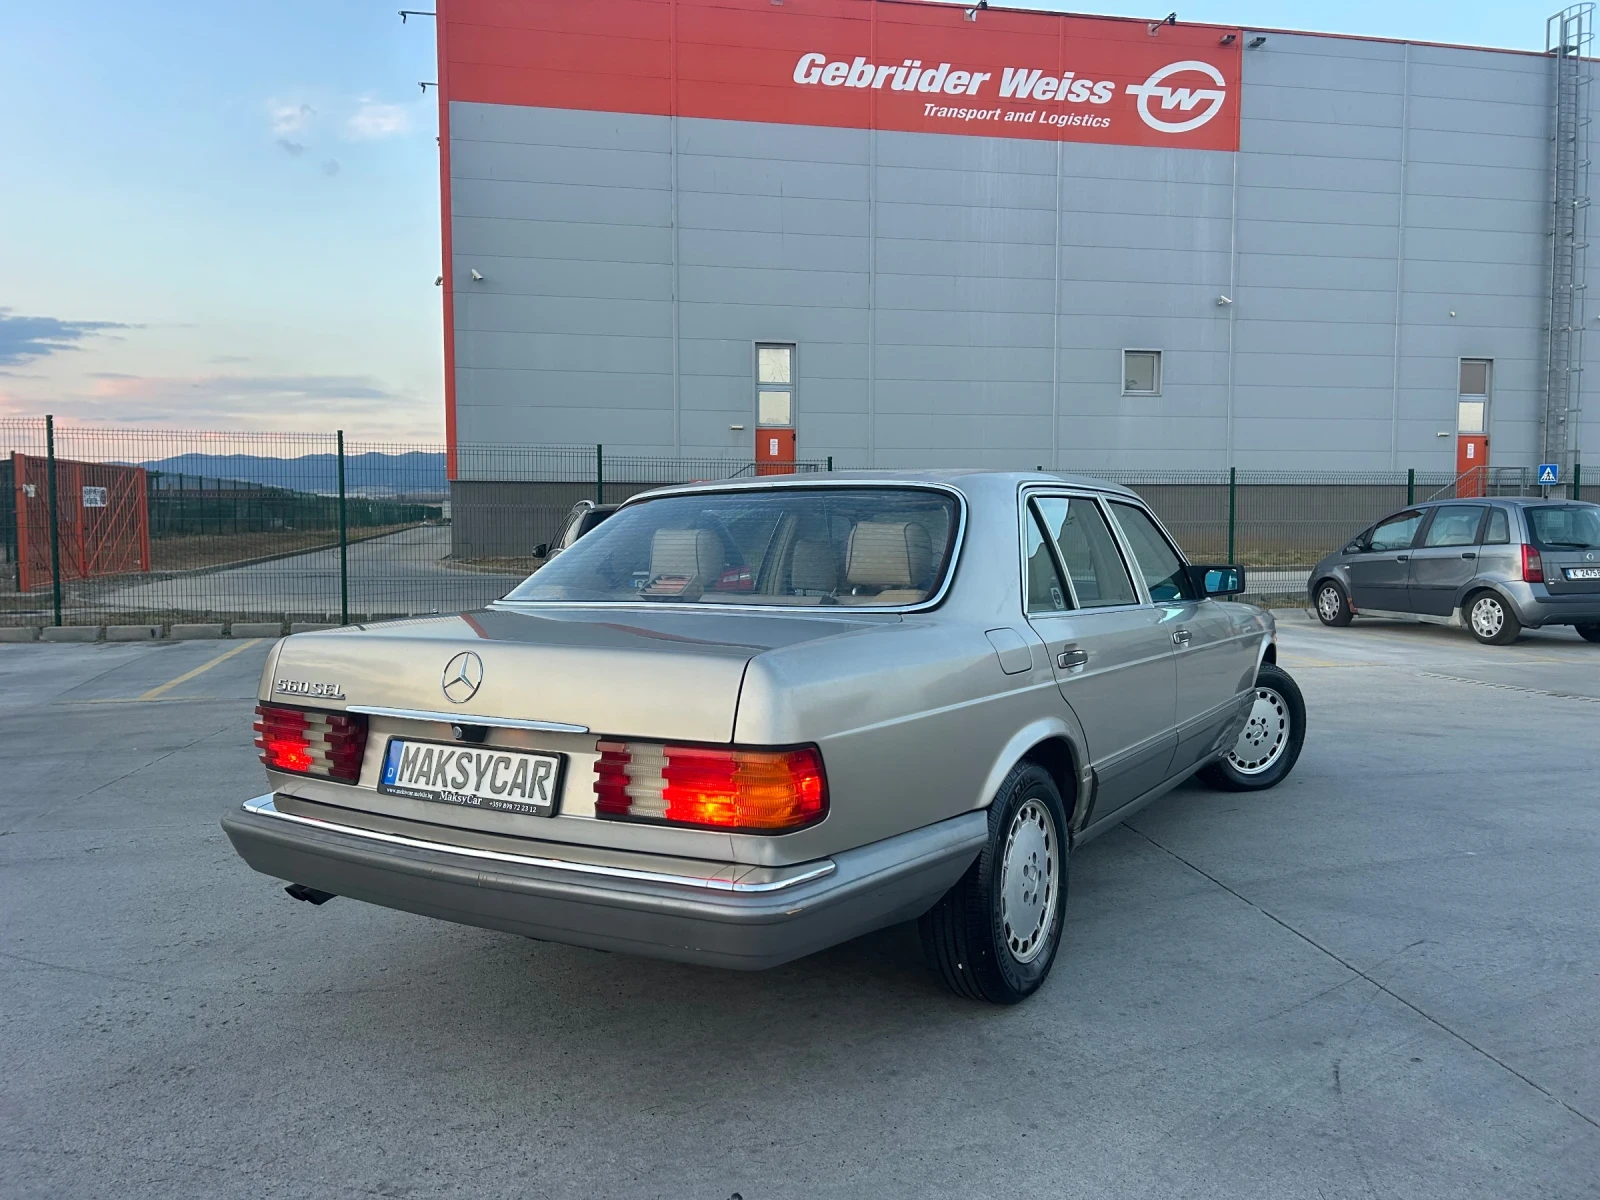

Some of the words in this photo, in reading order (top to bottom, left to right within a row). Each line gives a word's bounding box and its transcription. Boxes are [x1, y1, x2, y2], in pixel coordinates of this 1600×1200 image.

[793, 52, 991, 96] Gebrüder
[998, 67, 1115, 104] Weiss
[923, 103, 1001, 121] Transport
[1004, 108, 1036, 124] and
[1038, 112, 1111, 128] Logistics
[277, 678, 309, 693] 560
[312, 682, 345, 698] SEL
[387, 767, 394, 777] D
[398, 746, 552, 800] MAKSYCAR
[438, 789, 482, 806] MaksyCar
[513, 803, 521, 811] 72
